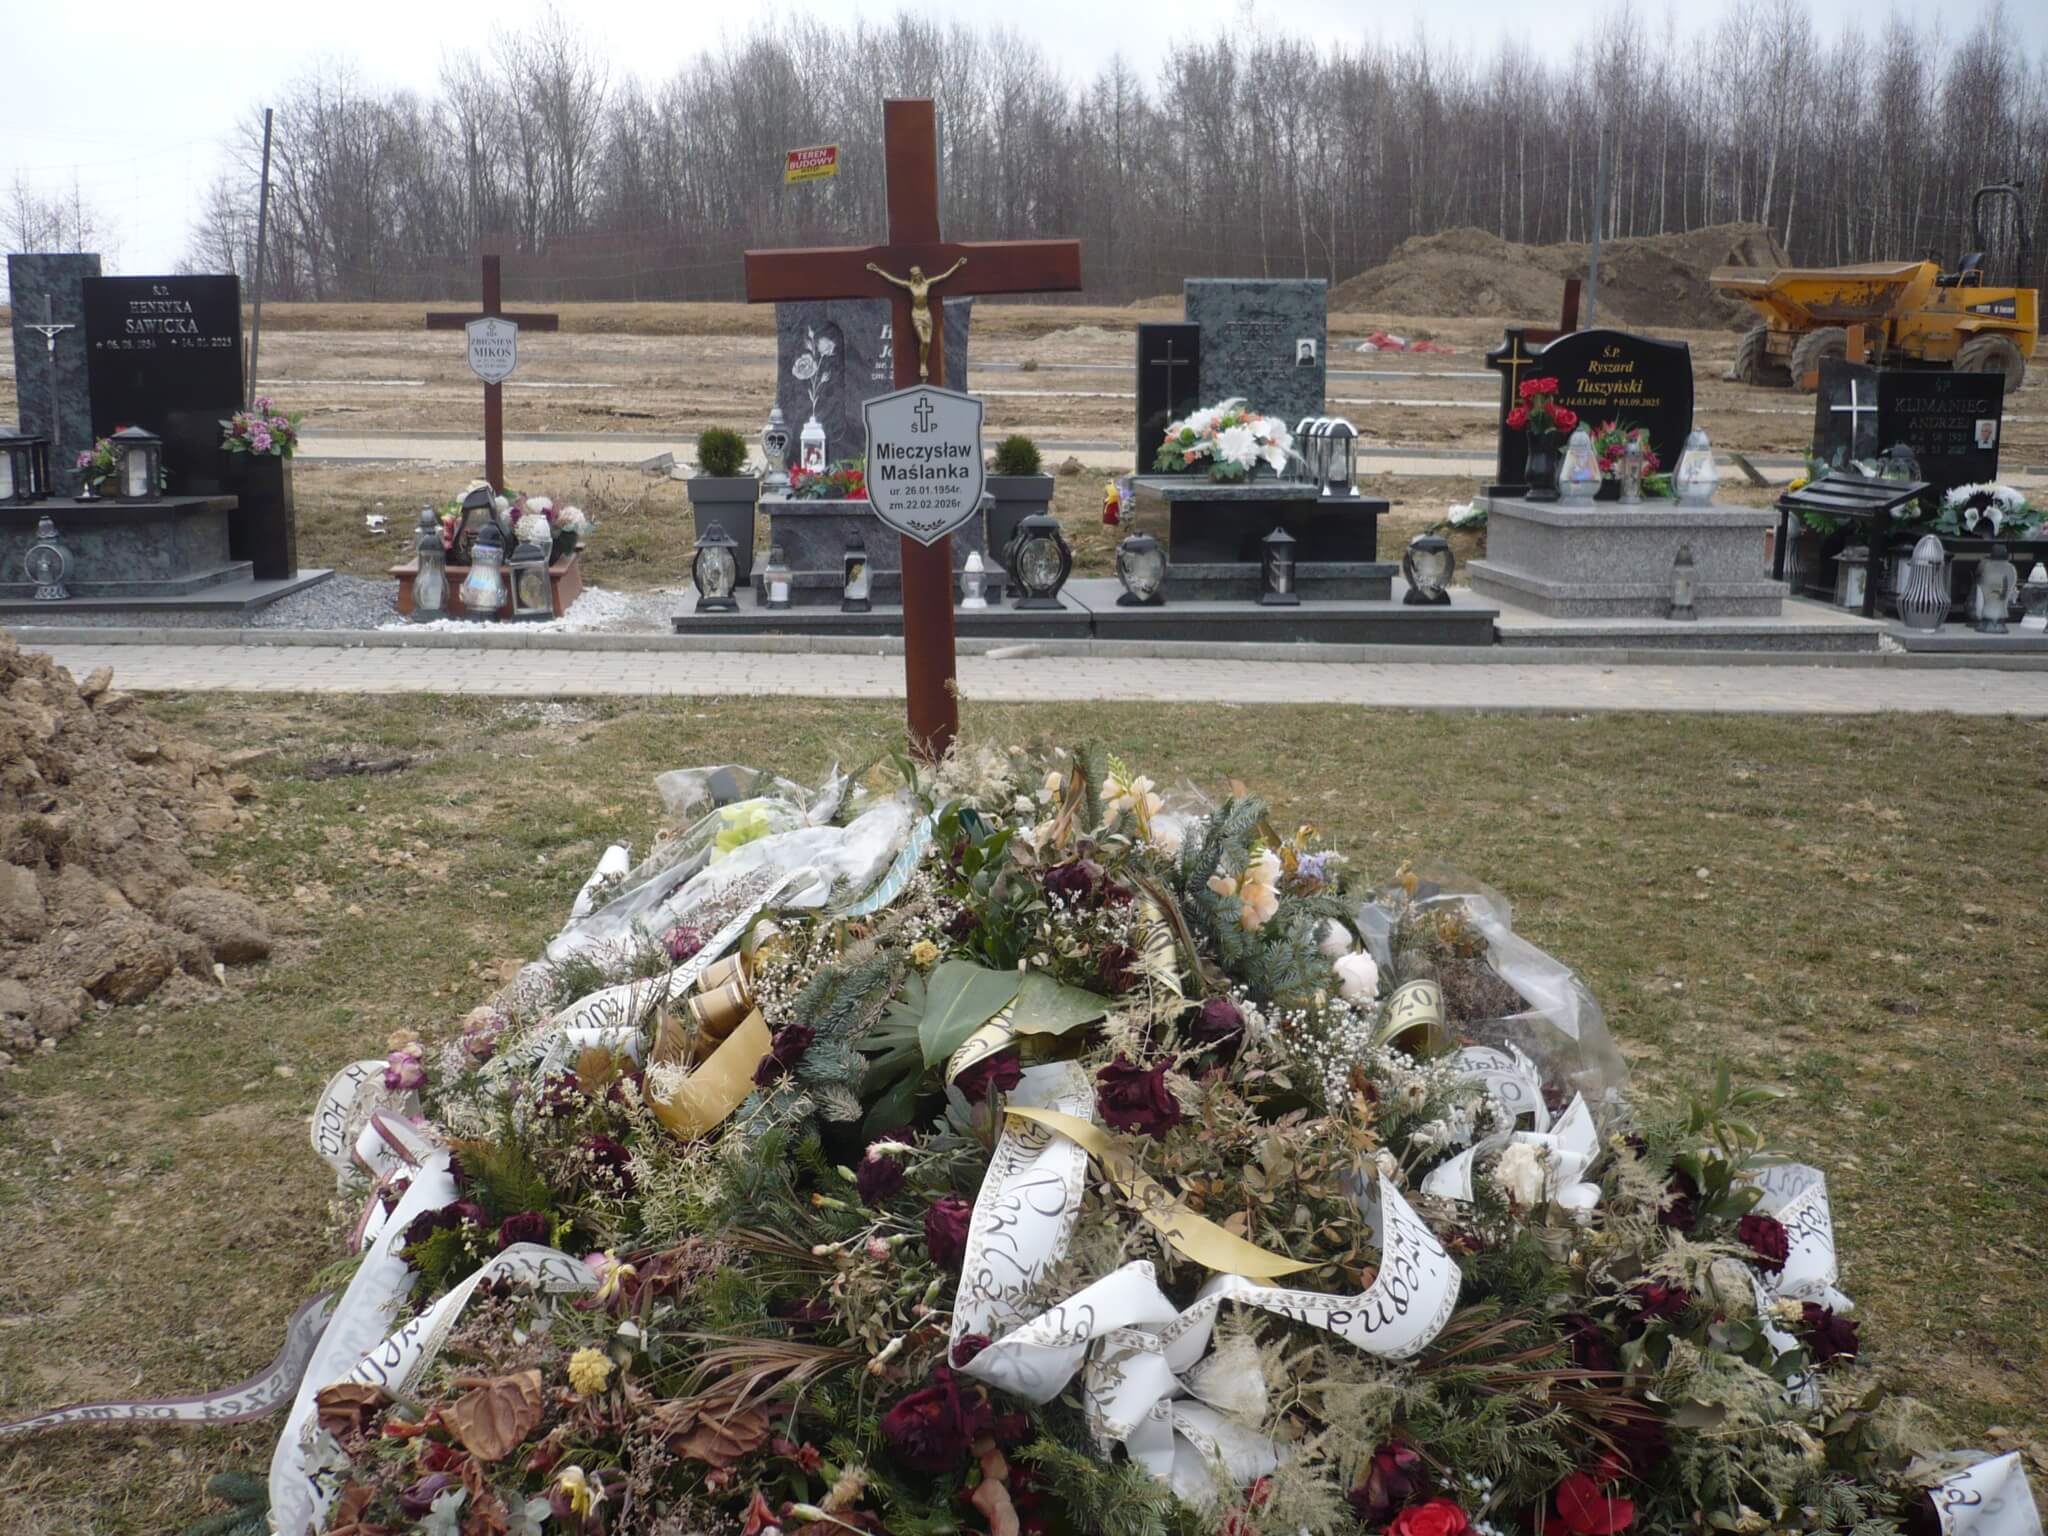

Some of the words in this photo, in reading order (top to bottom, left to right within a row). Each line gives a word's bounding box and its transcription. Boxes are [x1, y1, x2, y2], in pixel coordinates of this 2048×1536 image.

[129, 300, 192, 314] HENRYKA
[125, 318, 199, 334] SAWICKA
[1588, 360, 1634, 375] Ryszard
[1577, 378, 1643, 396] Tuszyński
[876, 442, 971, 463] Mieczysław
[881, 464, 969, 481] Maślanka
